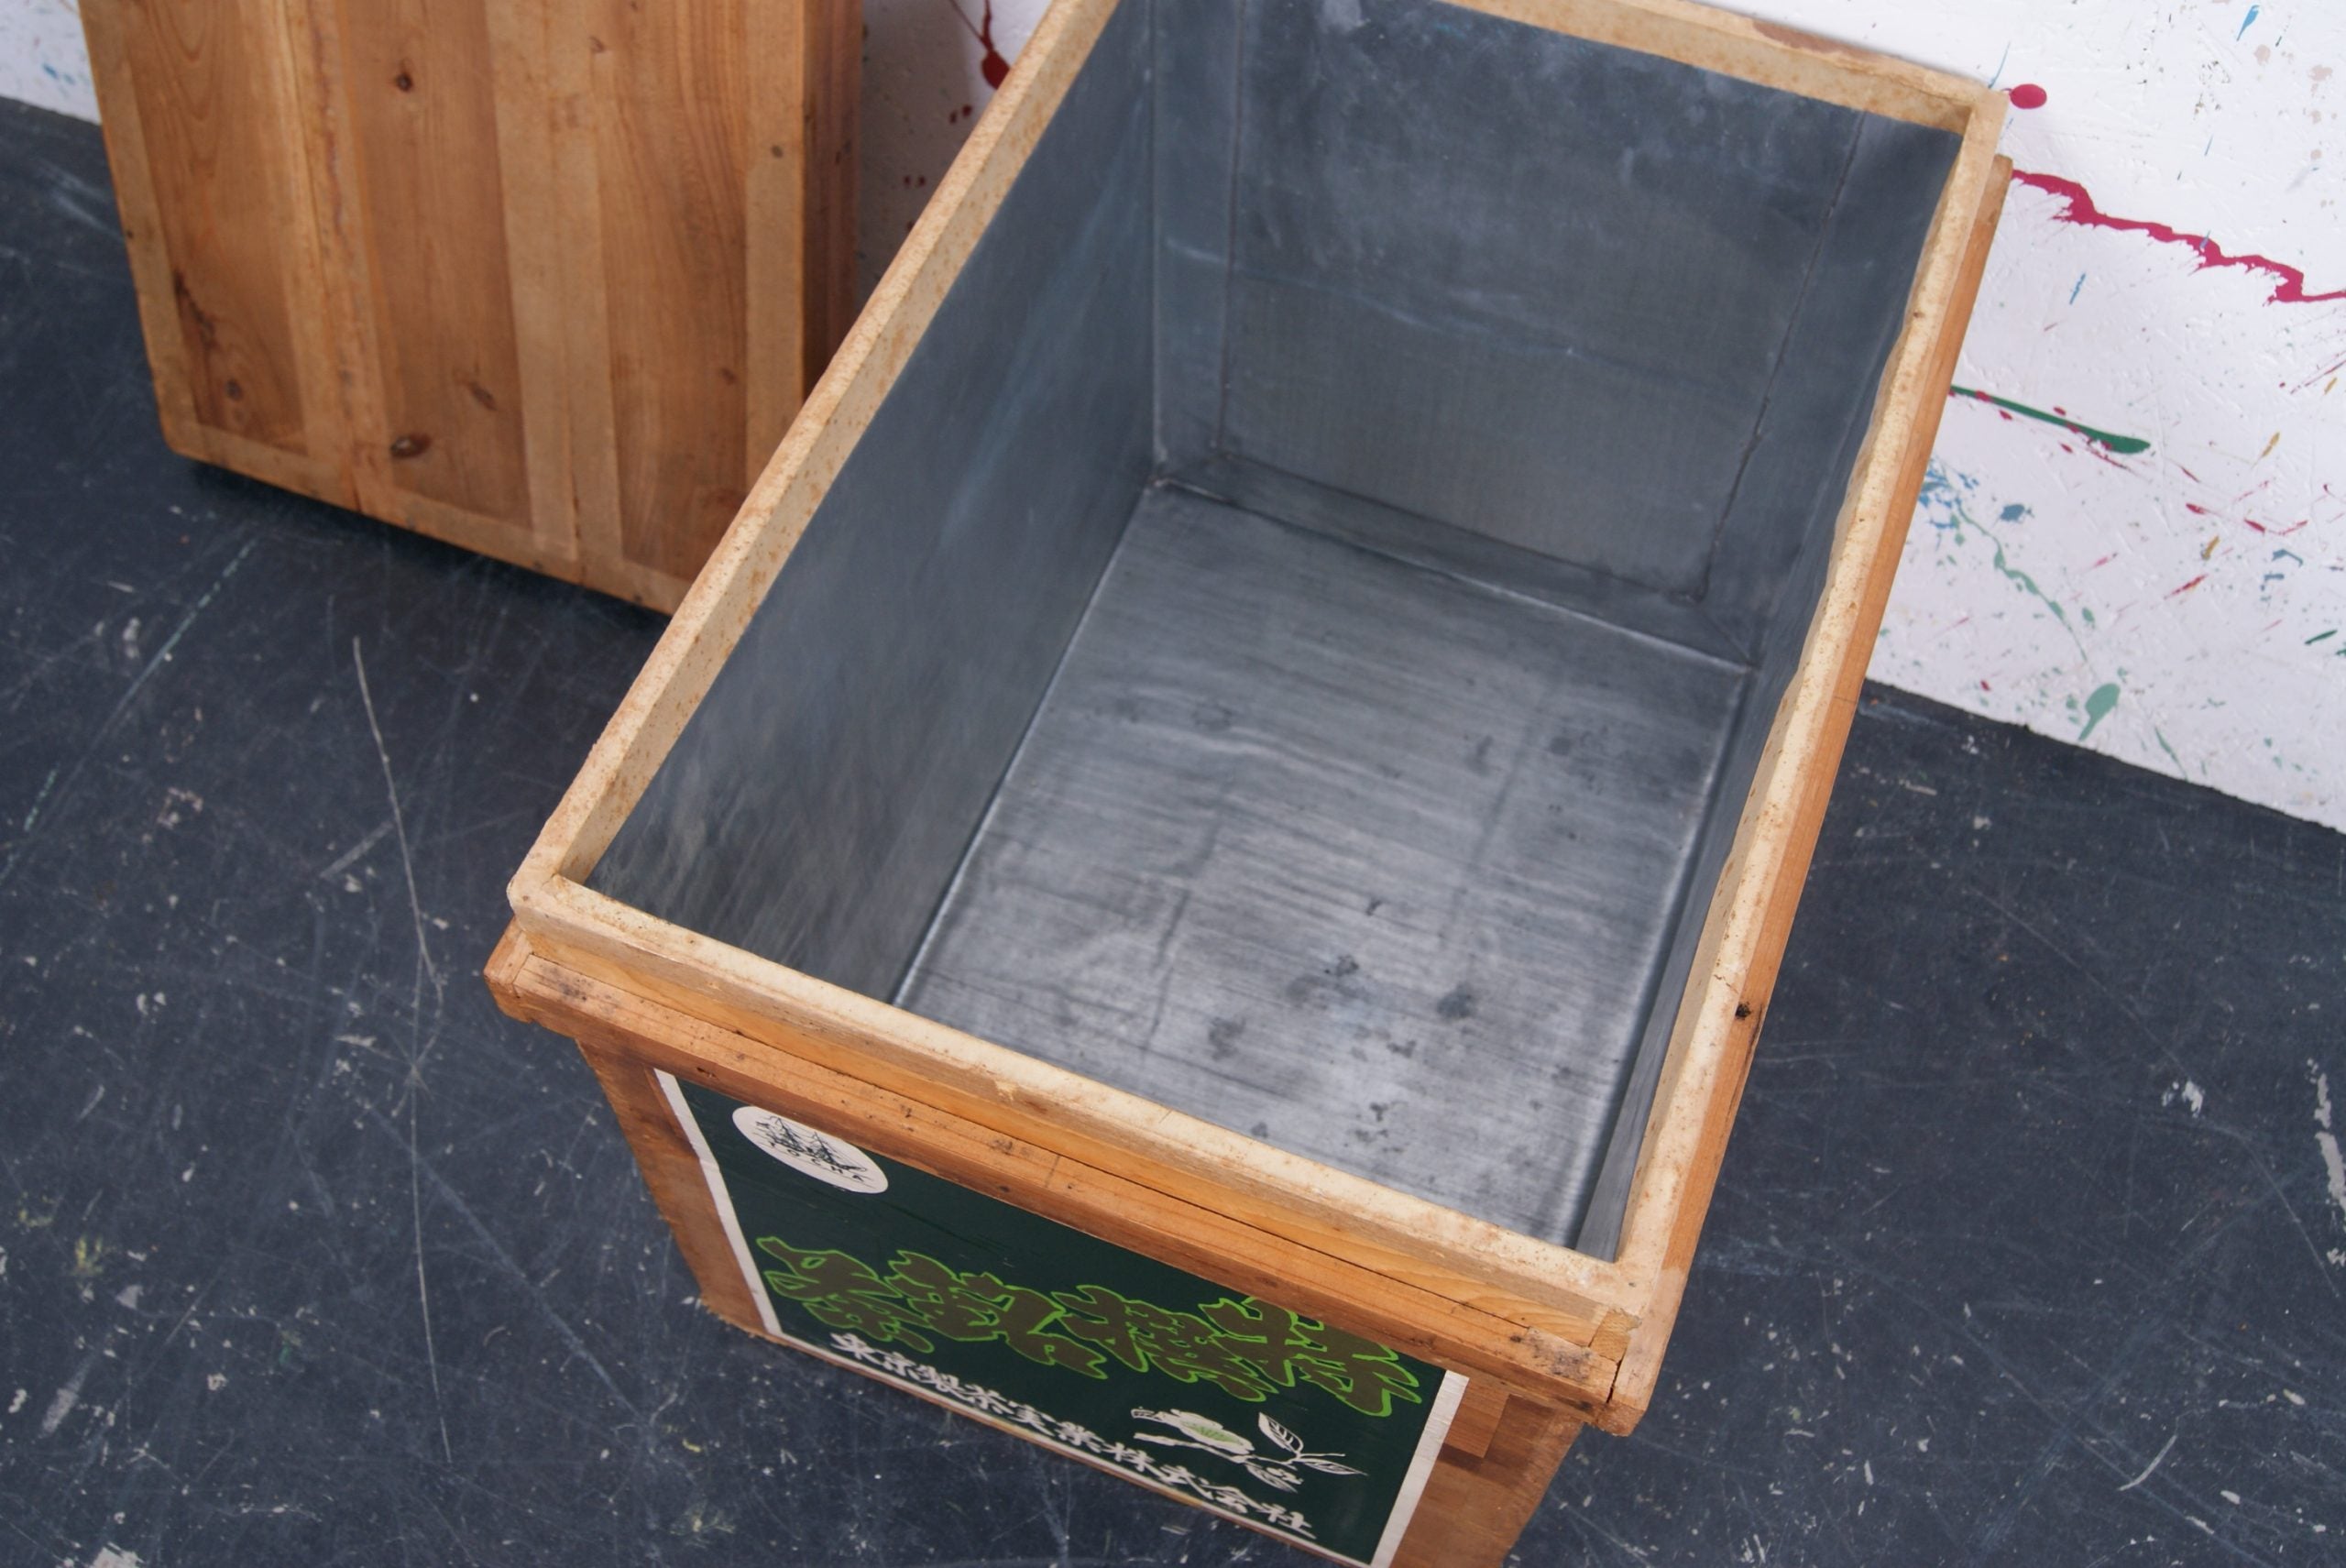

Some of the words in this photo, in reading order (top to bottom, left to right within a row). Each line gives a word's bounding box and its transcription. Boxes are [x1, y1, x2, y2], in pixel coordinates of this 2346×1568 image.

[768, 1140, 865, 1183] TOCHA
[829, 1332, 1318, 1540] 東京製茶実業株式会社
